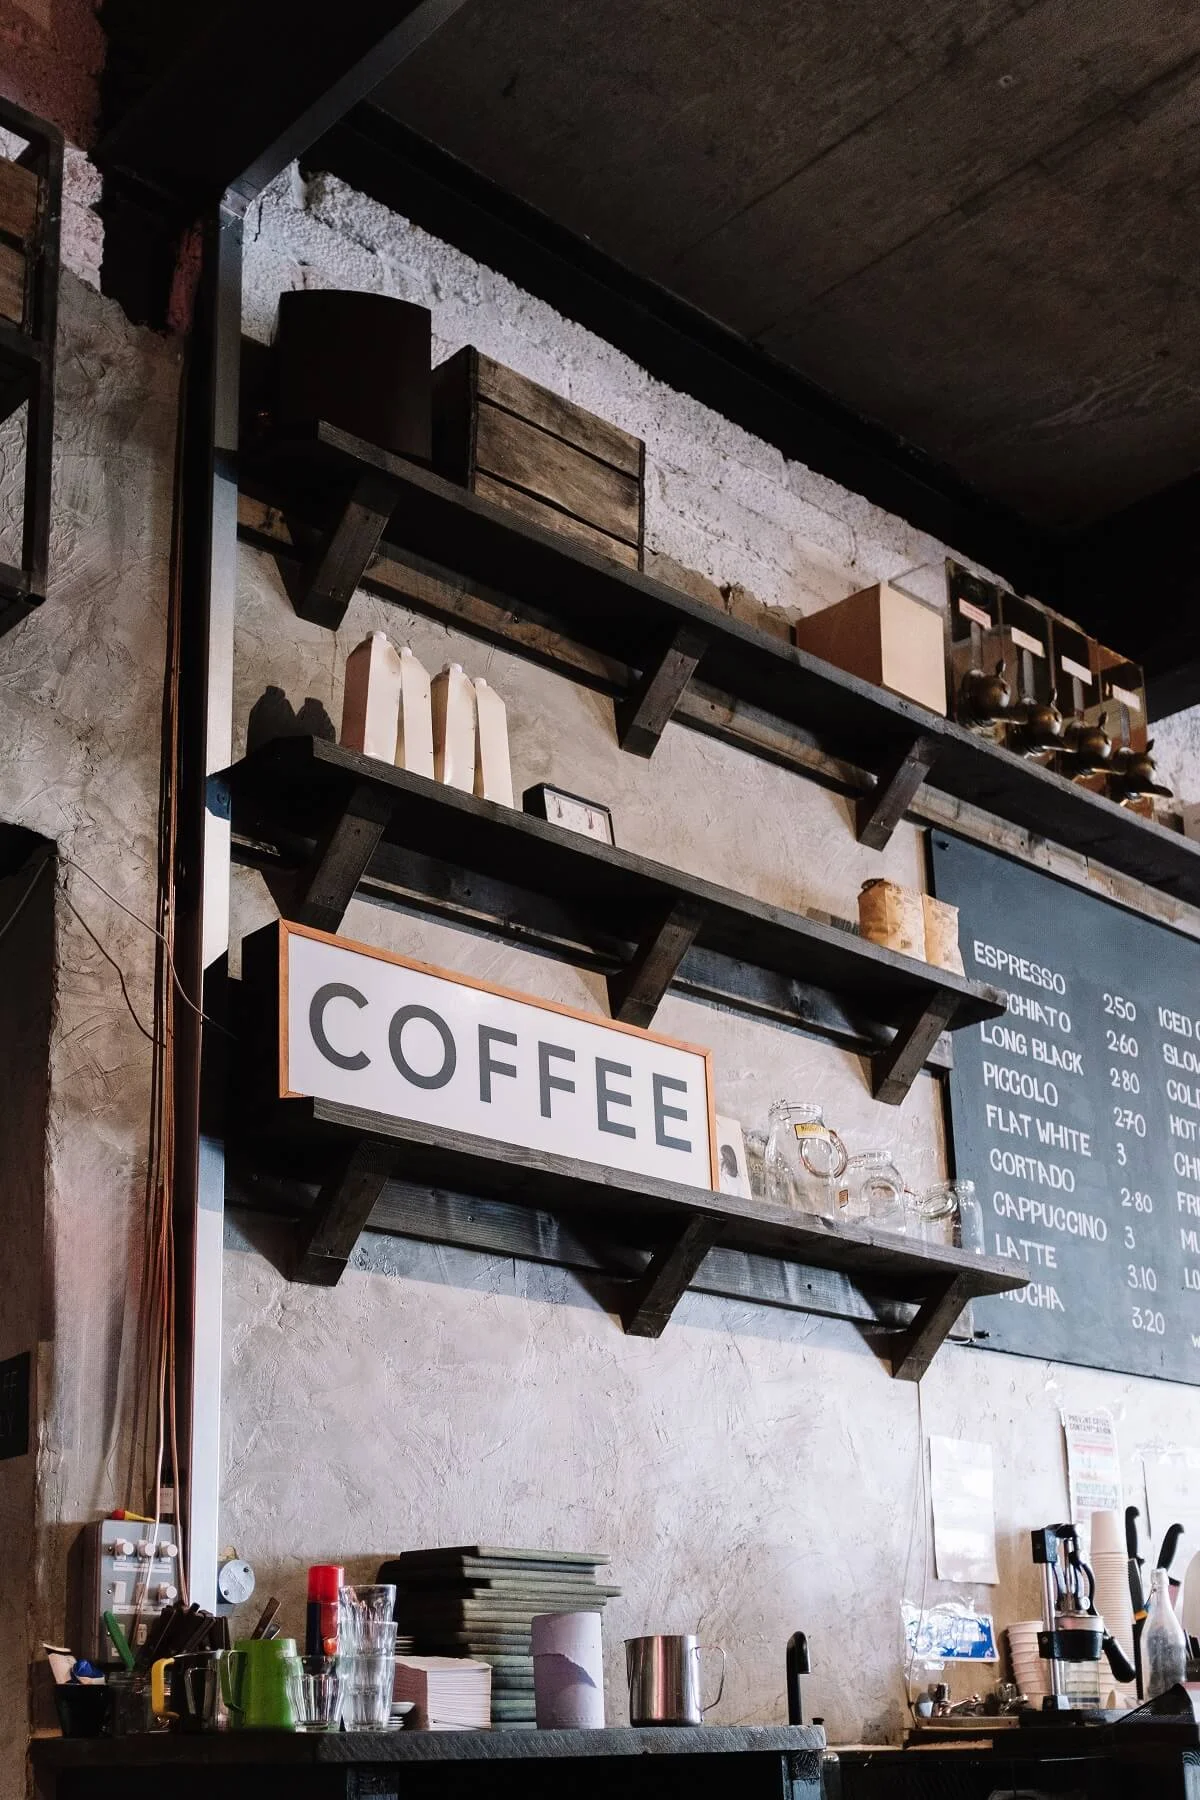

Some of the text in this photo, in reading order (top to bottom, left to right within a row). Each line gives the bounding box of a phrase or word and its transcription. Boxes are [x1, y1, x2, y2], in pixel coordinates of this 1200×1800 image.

[974, 940, 1066, 995] ESPRESSO
[1005, 993, 1071, 1033] CHIATO
[1158, 1006, 1193, 1038] ICED
[309, 982, 692, 1153] COFFEE
[980, 1021, 1084, 1076] LONG BLACK
[983, 1061, 1058, 1107] PICCOLO
[986, 1104, 1092, 1157] FLAT WHITE
[1169, 1114, 1198, 1142] HOT
[990, 1148, 1075, 1193] CORTADO
[1116, 1142, 1127, 1166] 3
[993, 1191, 1107, 1242] CAPPUCCINO
[995, 1233, 1058, 1269] LATTE
[1124, 1226, 1136, 1249] 3
[1127, 1264, 1157, 1292] 3.10
[1132, 1306, 1165, 1335] 3.20
